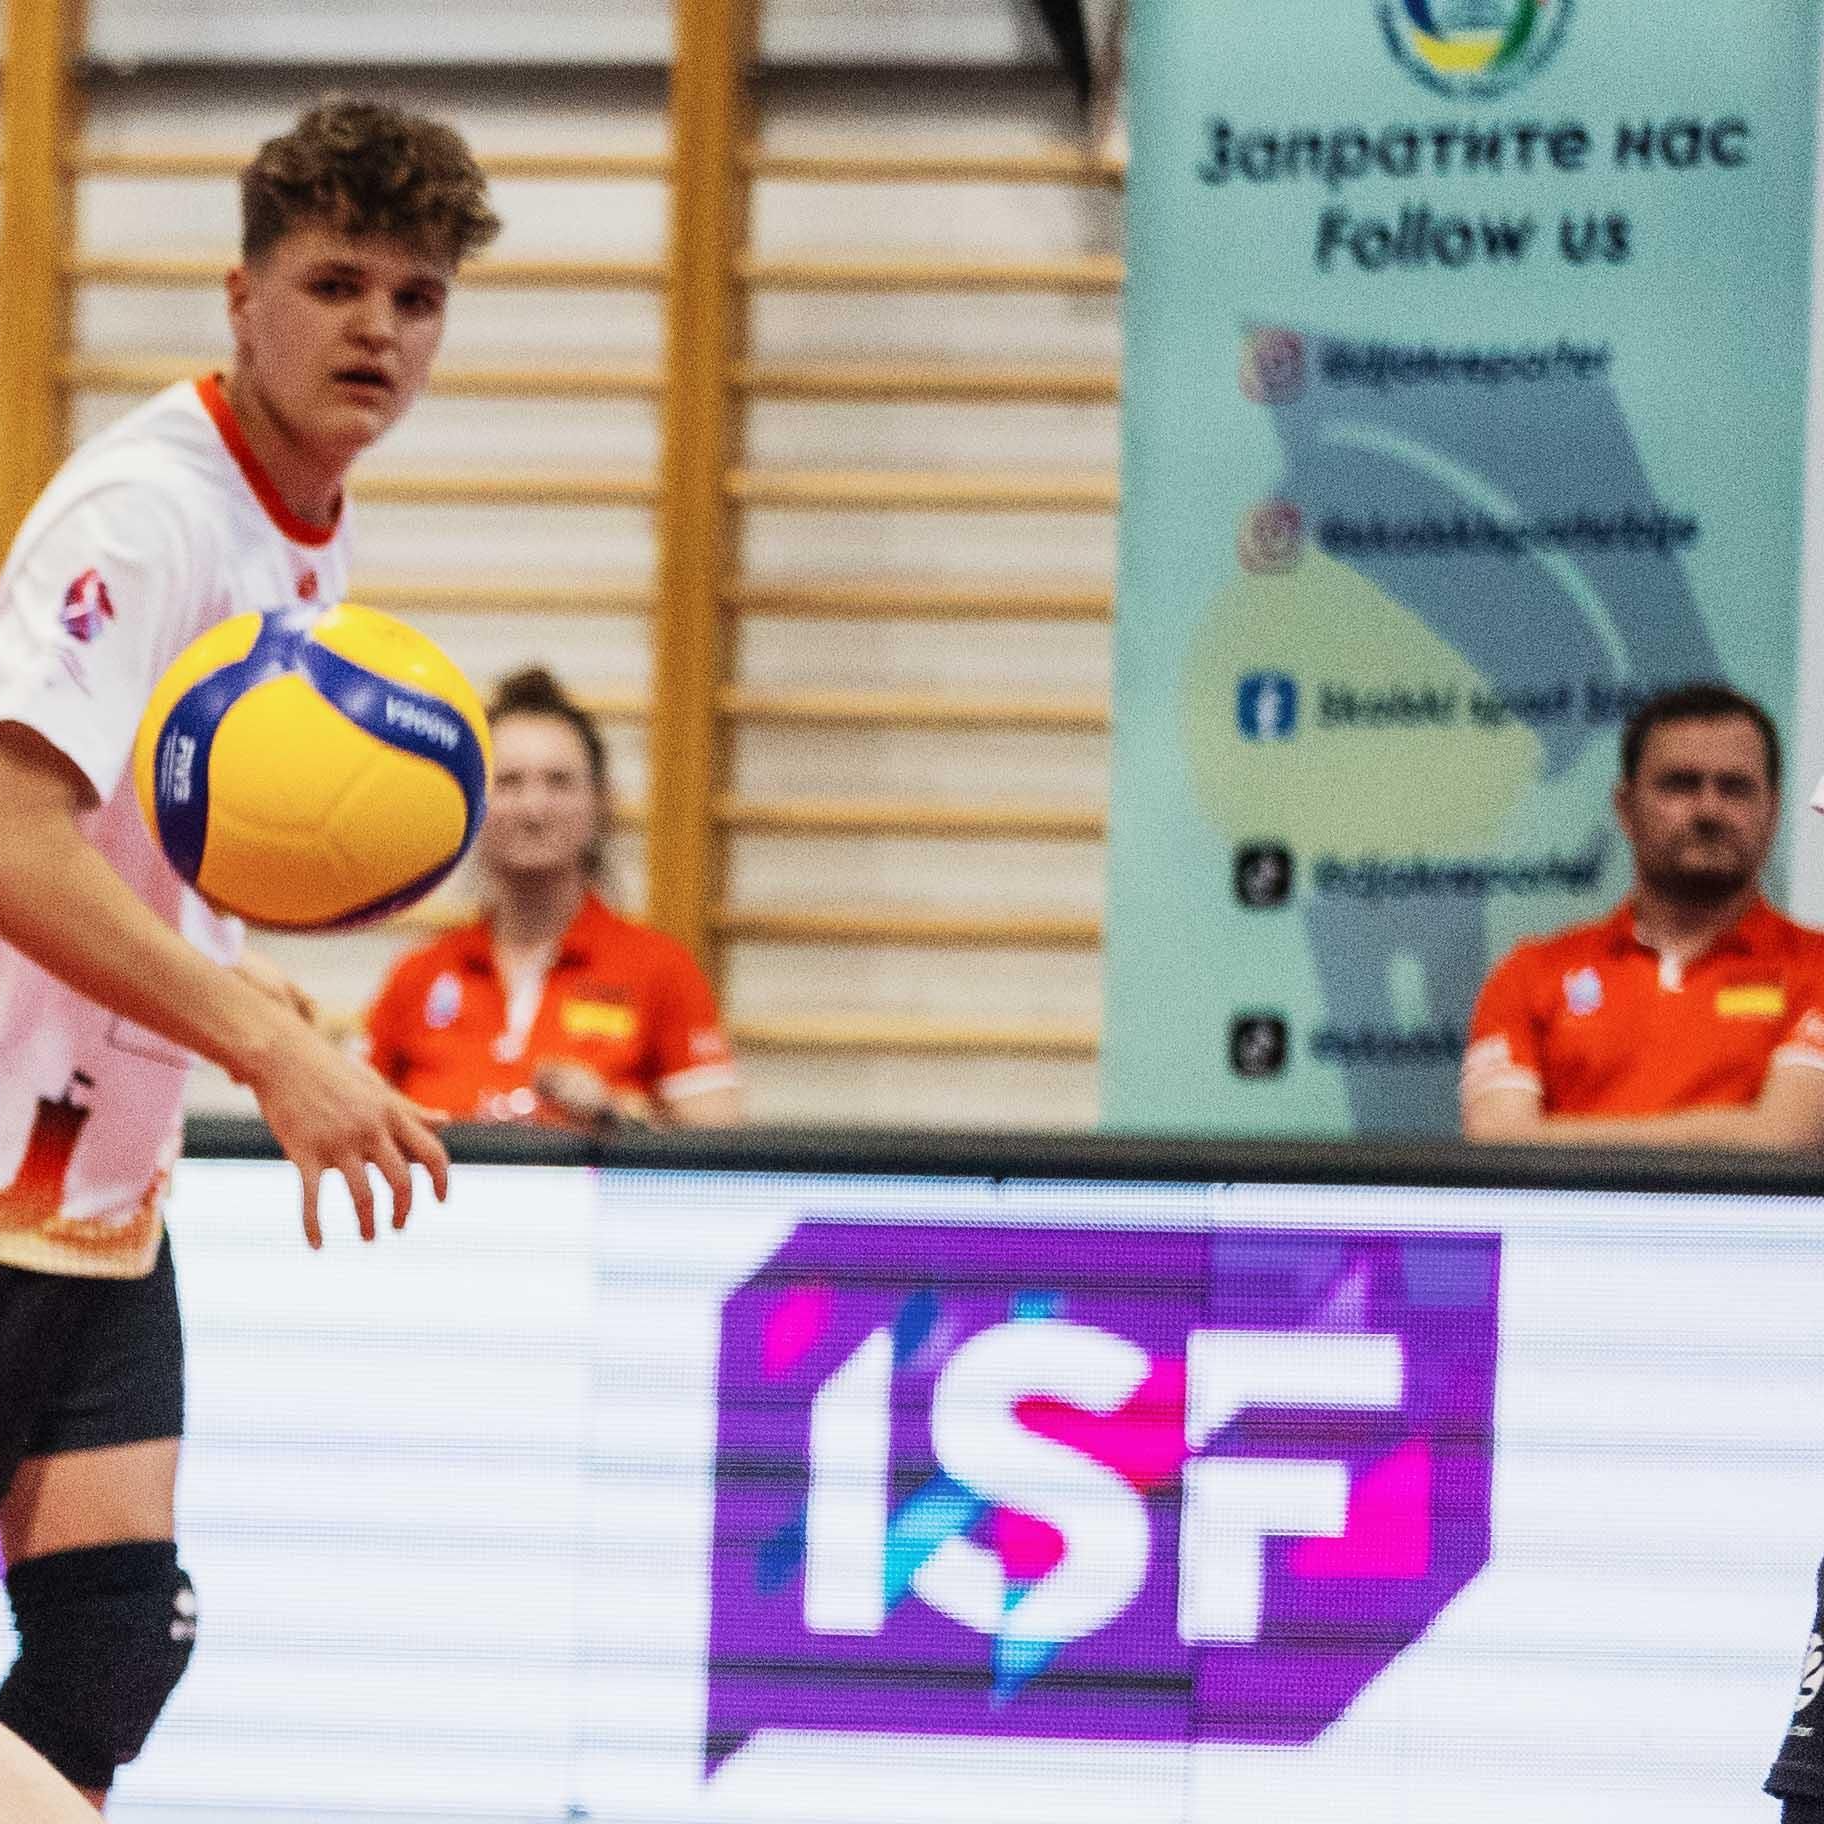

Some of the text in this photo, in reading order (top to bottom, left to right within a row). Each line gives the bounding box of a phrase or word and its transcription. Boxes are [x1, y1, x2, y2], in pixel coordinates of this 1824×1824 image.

[1198, 116, 1749, 188] Запратите нас
[1314, 202, 1632, 272] Follow us
[802, 1318, 1404, 1648] ISF
